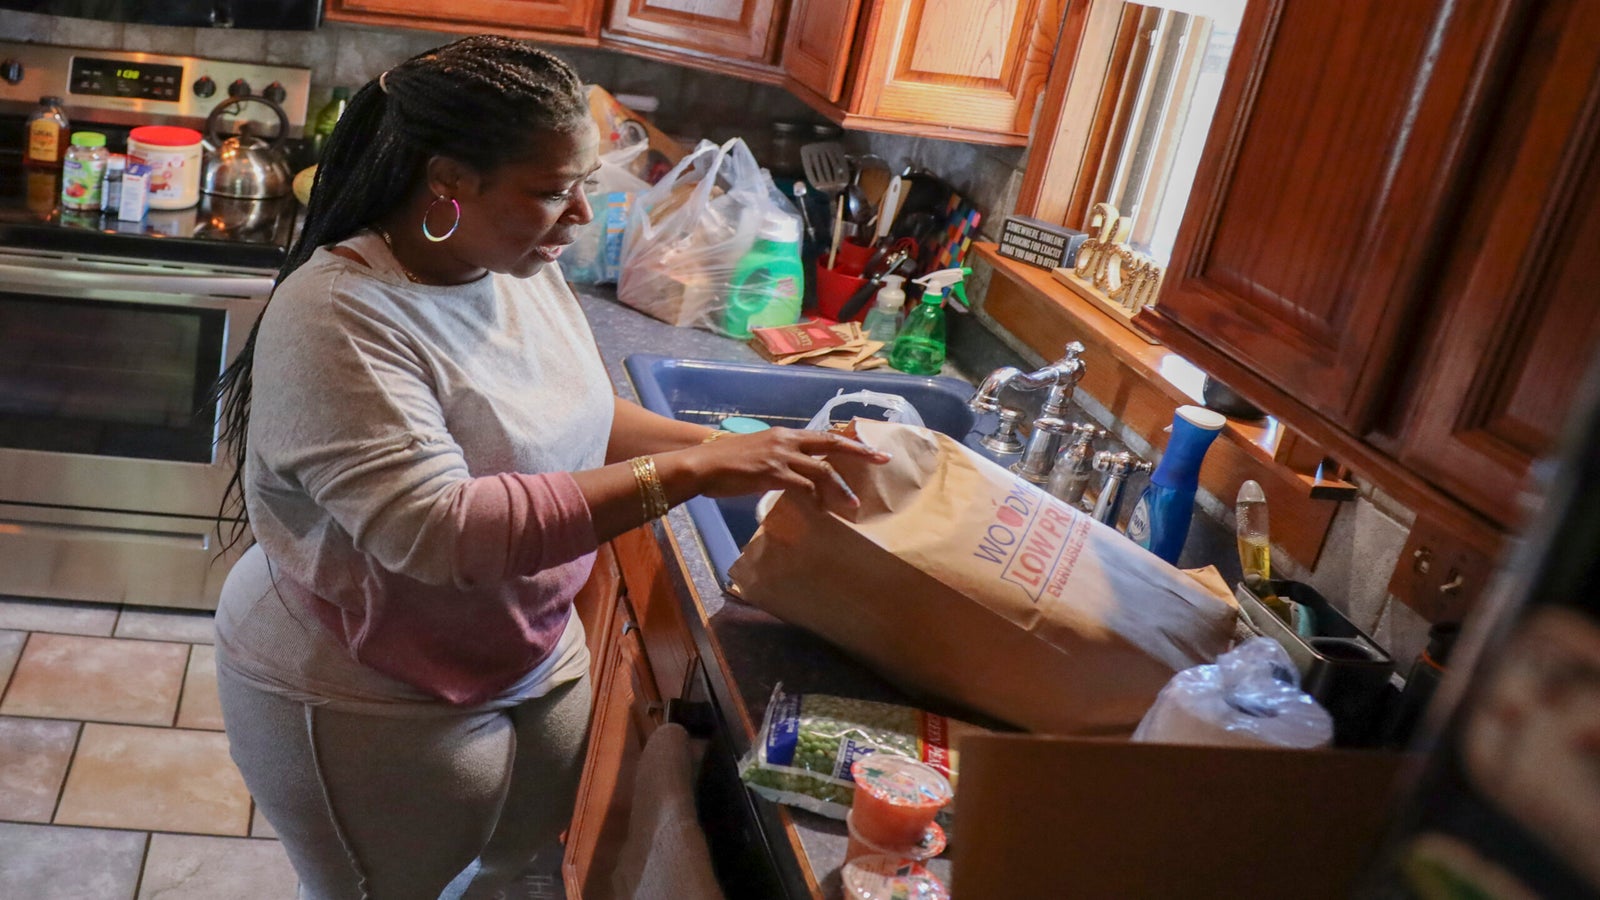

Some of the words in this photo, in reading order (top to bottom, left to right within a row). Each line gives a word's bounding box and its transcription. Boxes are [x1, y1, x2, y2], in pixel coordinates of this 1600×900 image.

[1004, 232, 1010, 241] IS
[1009, 233, 1031, 248] LOOKING
[1030, 241, 1041, 252] FOR
[1040, 243, 1062, 258] EXACTLY
[1007, 221, 1039, 239] SOMEWHERE
[1040, 231, 1065, 247] SOMEONE
[1001, 243, 1015, 255] WHAT
[1015, 247, 1025, 258] YOU
[1024, 251, 1037, 262] HAVE
[1037, 254, 1043, 264] TO
[1043, 257, 1059, 269] OFFER
[1011, 530, 1056, 587] LOW
[1046, 564, 1072, 598] EVERY
